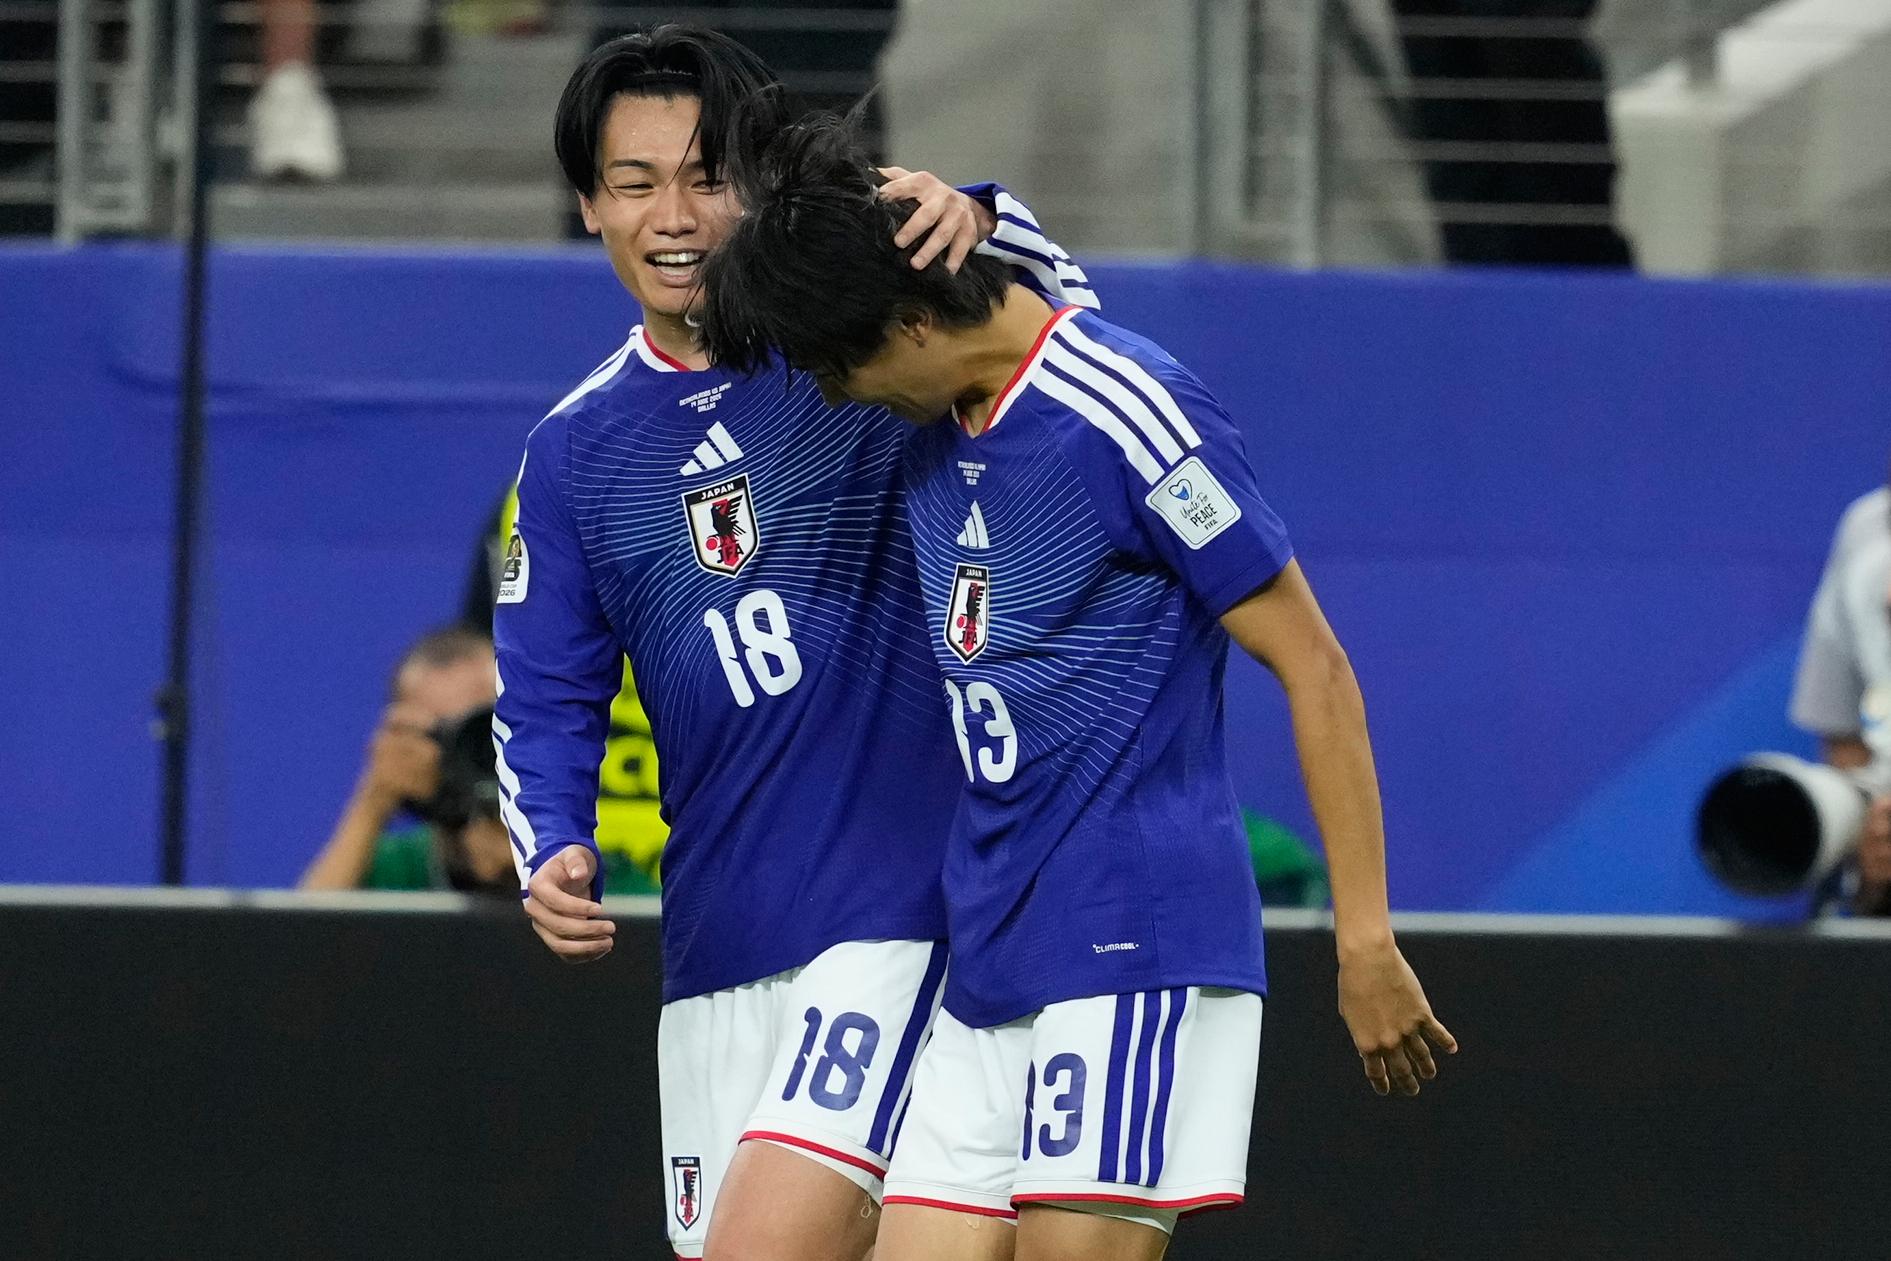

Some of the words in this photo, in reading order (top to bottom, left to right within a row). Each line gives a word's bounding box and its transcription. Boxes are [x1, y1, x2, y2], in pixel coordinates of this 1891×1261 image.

[701, 483, 735, 500] JAPAN
[1190, 503, 1218, 528] PEACE
[1204, 519, 1218, 530] FIFA
[966, 568, 983, 577] JAPAN
[498, 589, 516, 597] 026
[704, 589, 803, 708] 18
[945, 679, 1018, 783] 13
[782, 1006, 881, 1111] 18
